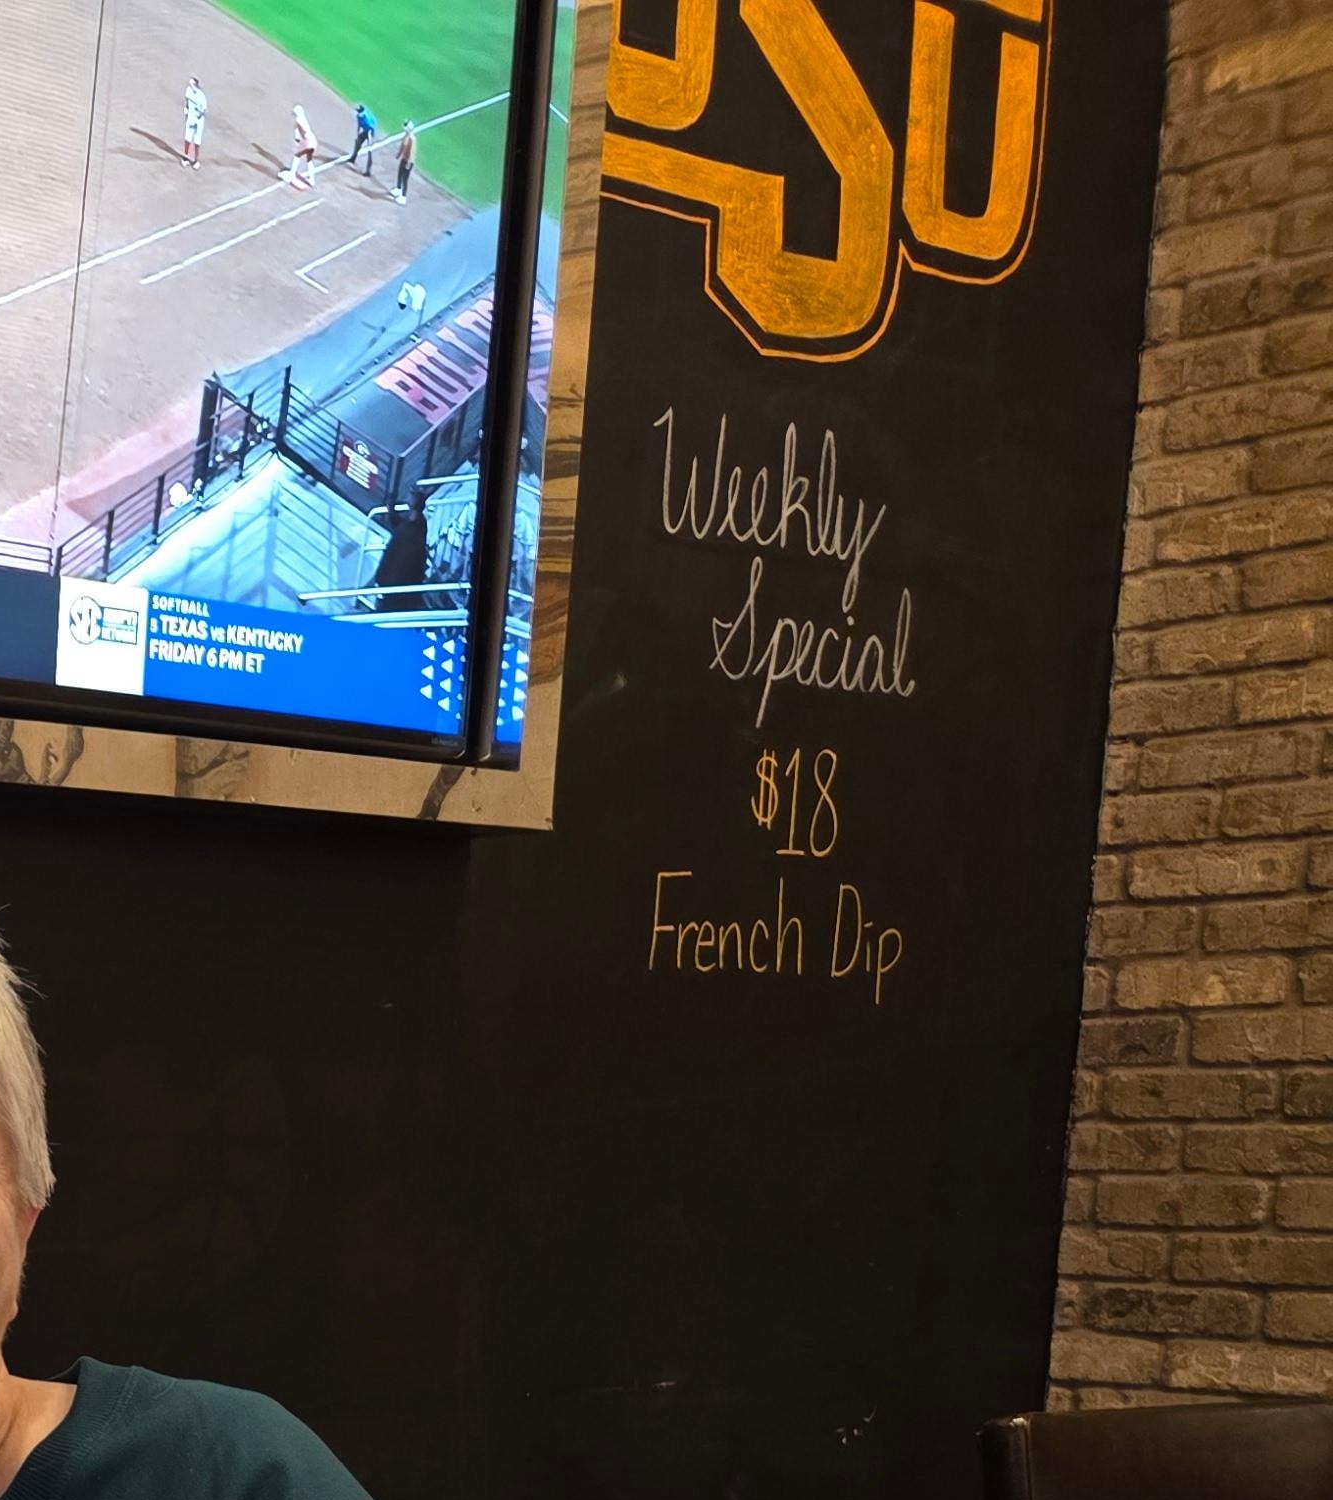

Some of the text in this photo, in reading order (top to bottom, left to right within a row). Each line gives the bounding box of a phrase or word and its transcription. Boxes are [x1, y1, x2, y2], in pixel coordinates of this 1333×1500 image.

[653, 406, 886, 612] Weekly
[149, 637, 265, 673] FRIDAY 6 PM ET
[151, 594, 209, 617] SOFTBALL
[160, 614, 208, 640] TEXAS
[226, 624, 303, 654] KENTUCKY
[710, 556, 915, 728] Special
[751, 747, 837, 857] $18
[649, 870, 903, 1005] French Dip
